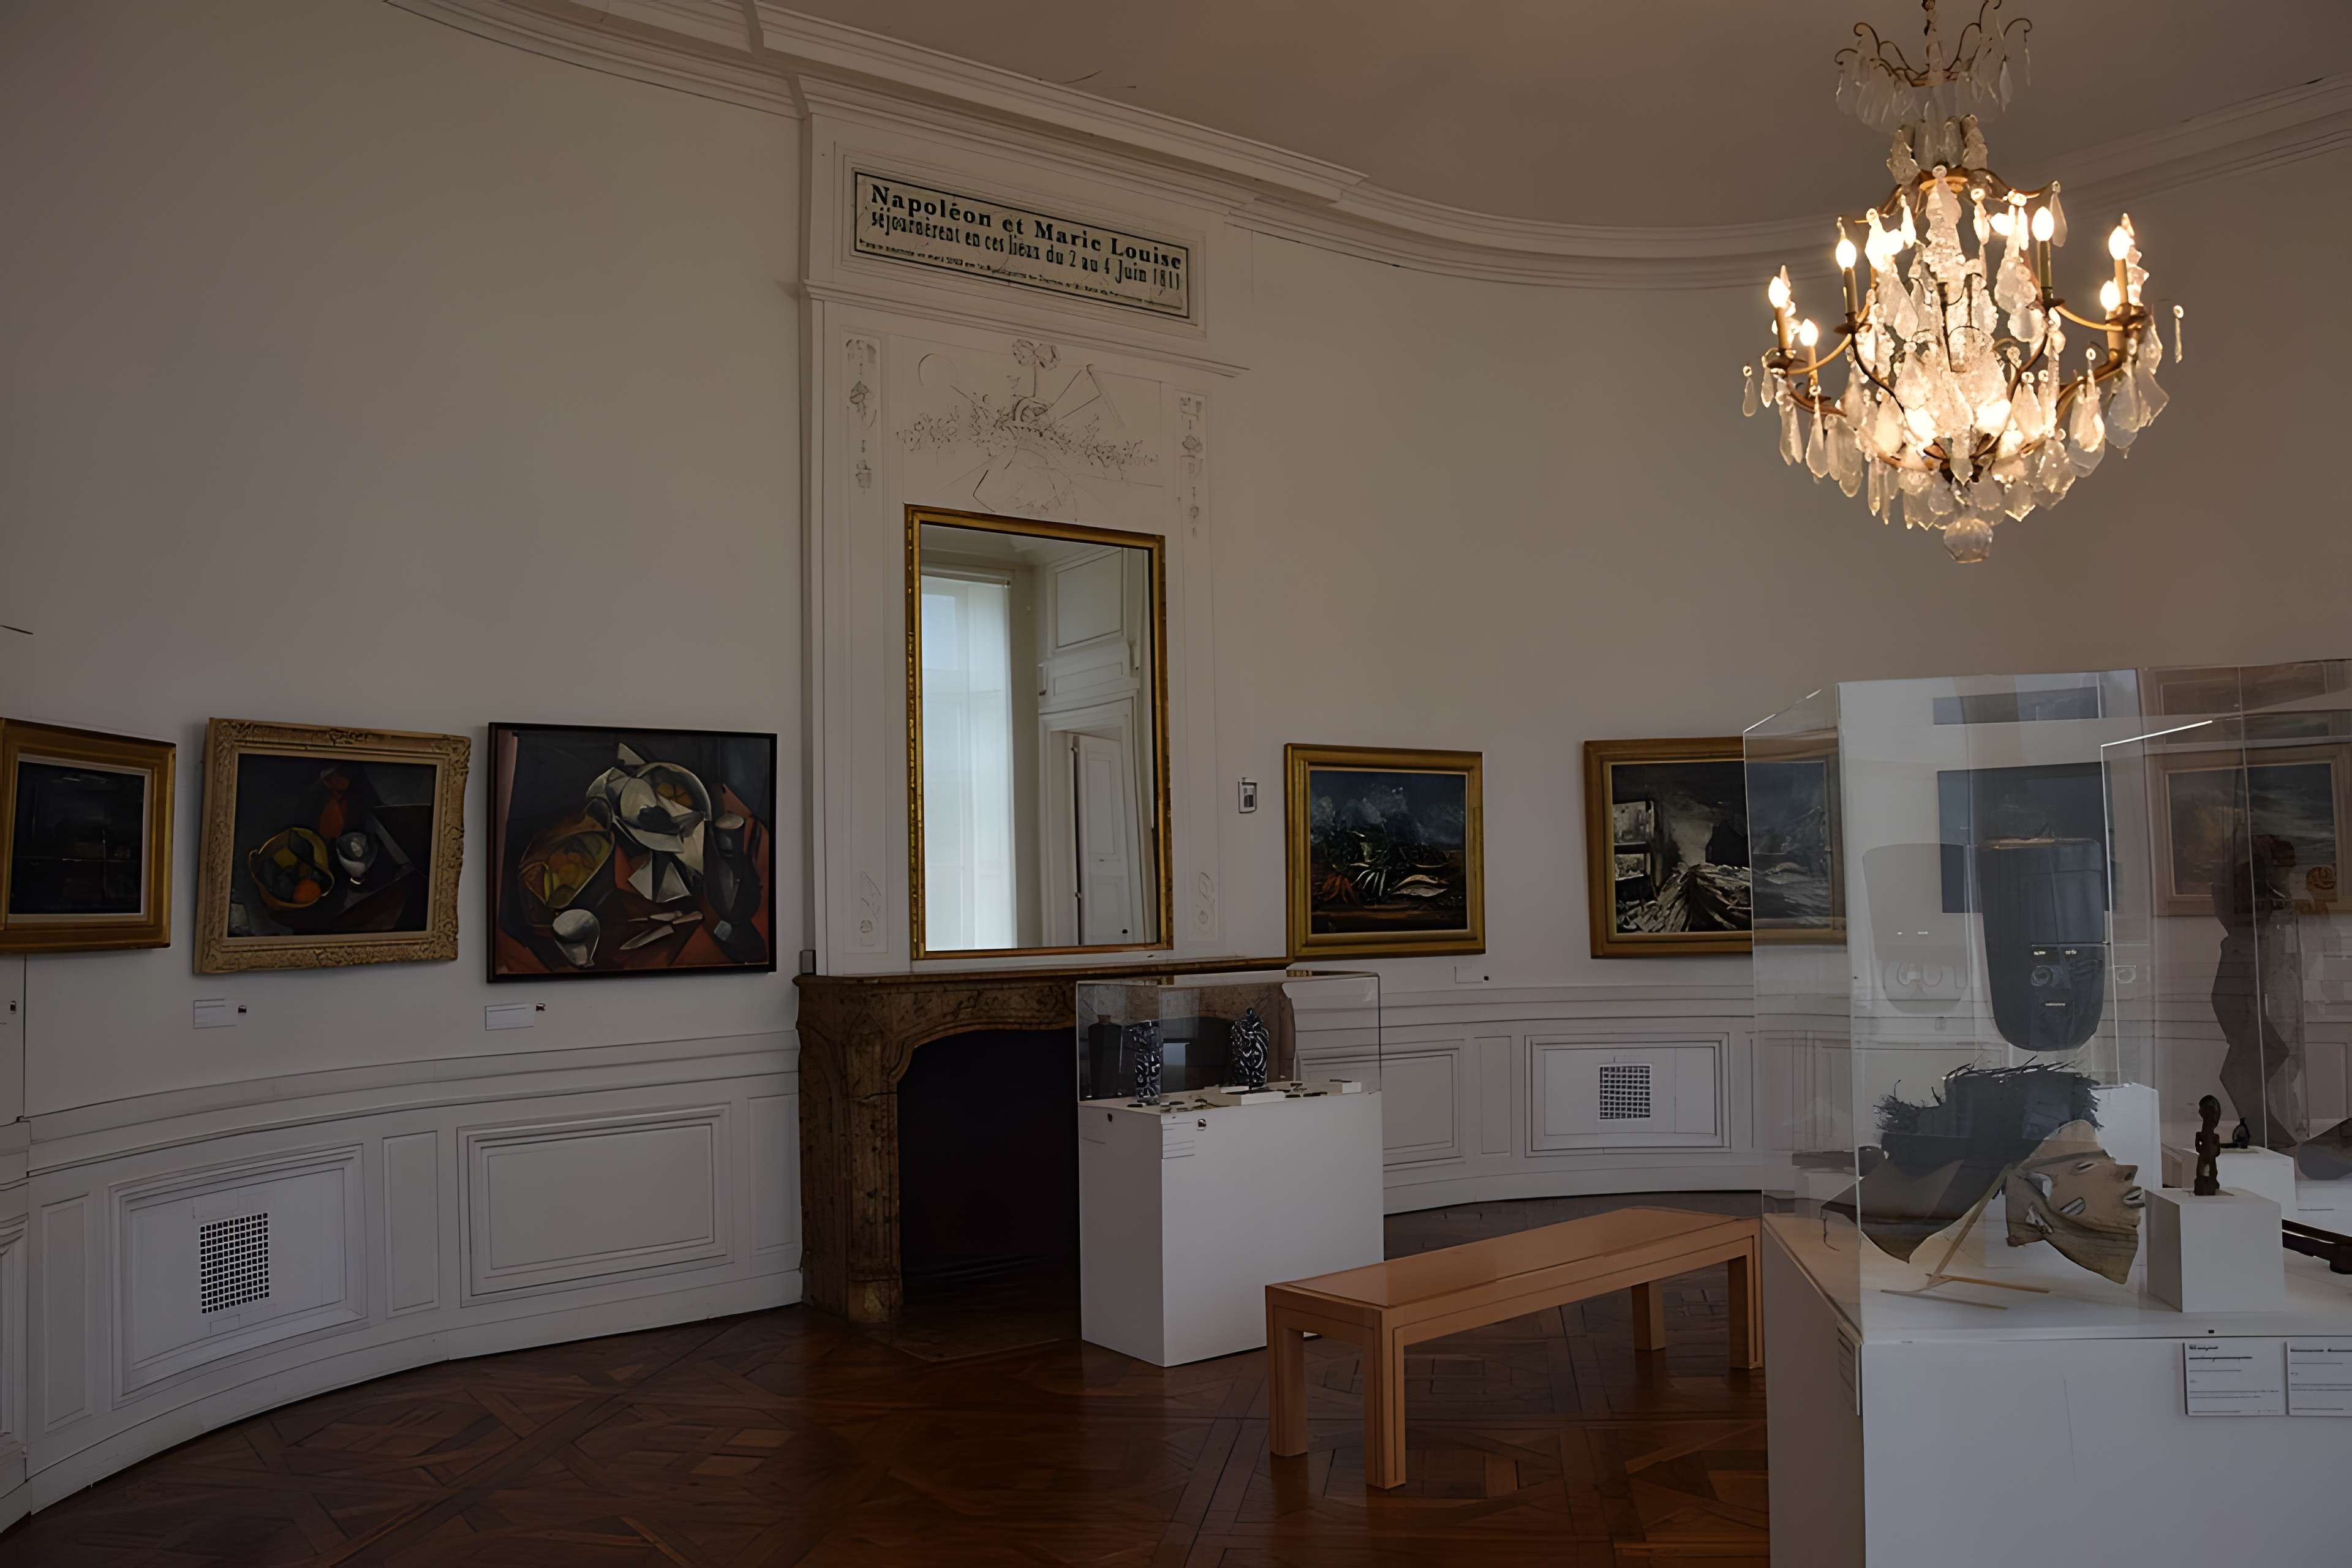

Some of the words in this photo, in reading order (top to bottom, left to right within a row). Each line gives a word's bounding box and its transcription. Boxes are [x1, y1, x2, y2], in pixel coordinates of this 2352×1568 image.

[872, 184, 991, 227] Napoléon
[1002, 218, 1023, 234] et
[1035, 221, 1101, 251] Marie
[1111, 238, 1181, 269] Louise
[966, 232, 980, 247] en
[986, 235, 1004, 252] ces
[1046, 244, 1063, 265] du
[1069, 251, 1076, 267] 2
[1082, 257, 1098, 273] au
[1115, 260, 1147, 284] Juin
[1153, 268, 1180, 290] 1811
